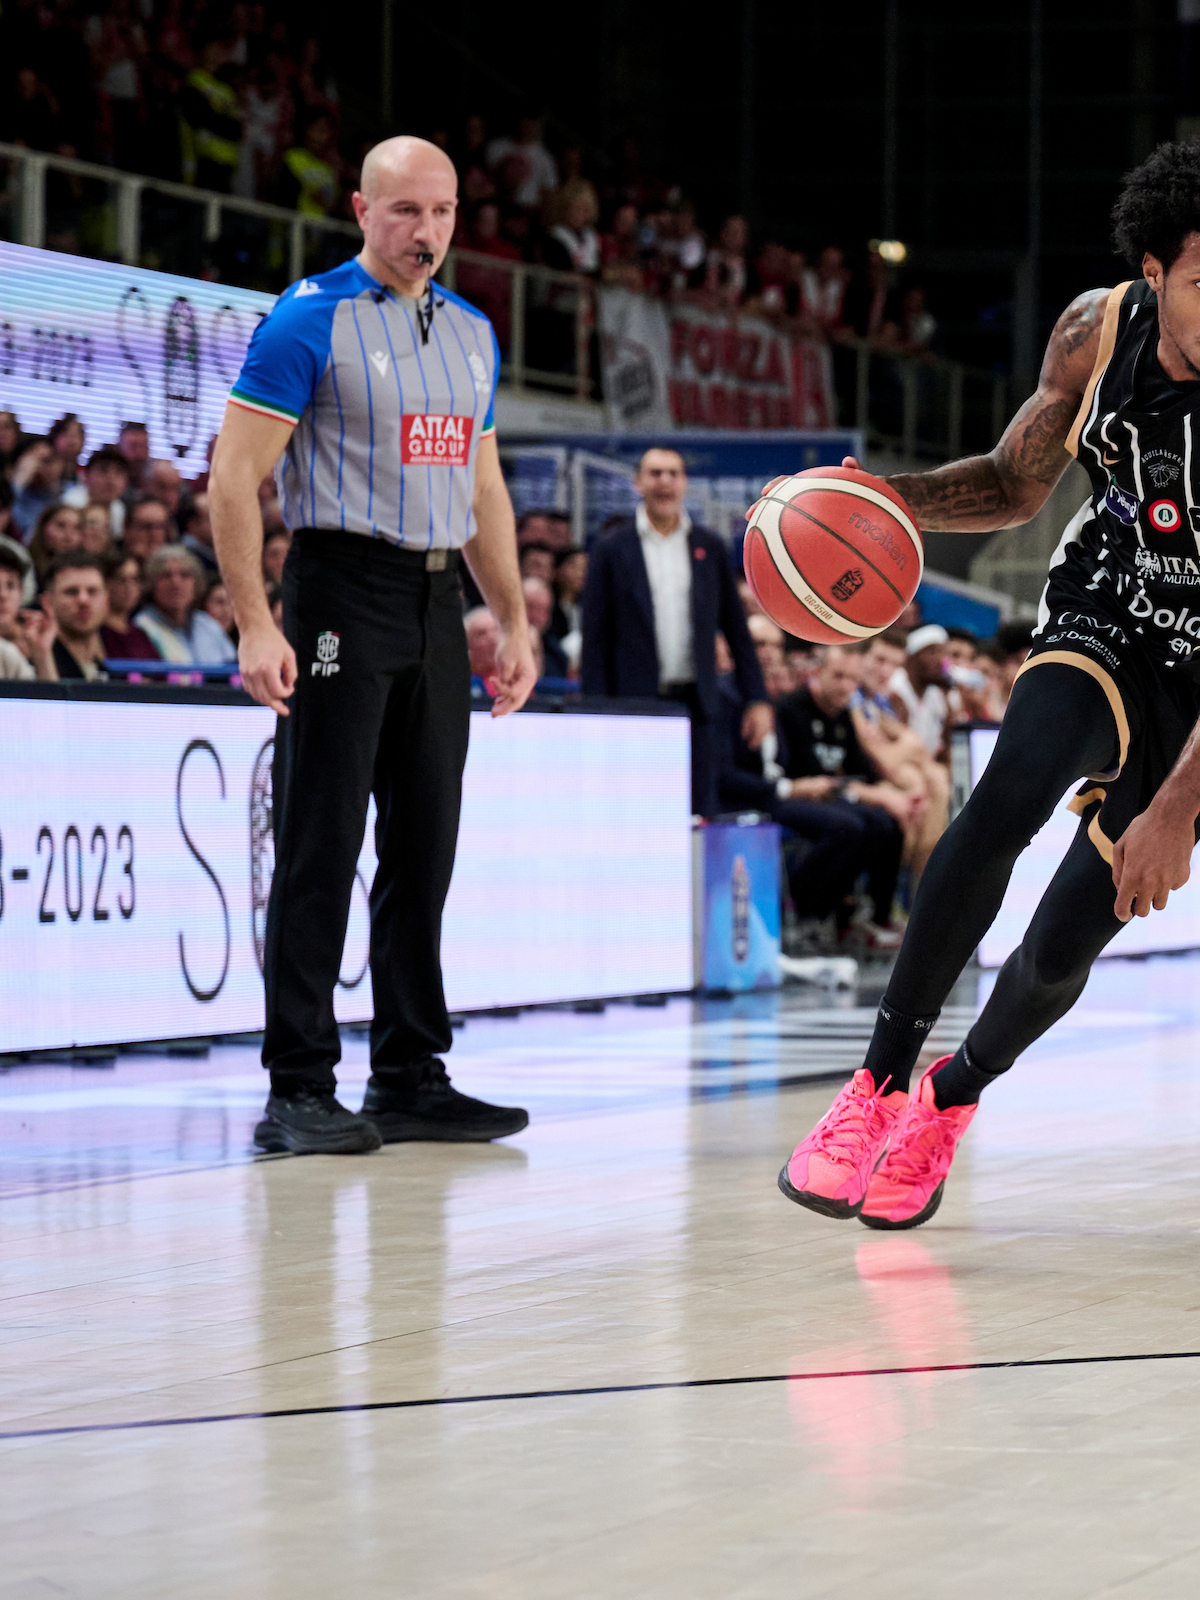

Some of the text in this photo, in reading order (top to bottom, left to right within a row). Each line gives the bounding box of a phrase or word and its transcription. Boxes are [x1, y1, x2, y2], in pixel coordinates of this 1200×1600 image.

[408, 415, 466, 441] ATTAL
[408, 439, 465, 456] GROUP
[847, 512, 908, 571] molten
[310, 661, 341, 678] FIP
[0, 824, 136, 923] -2023
